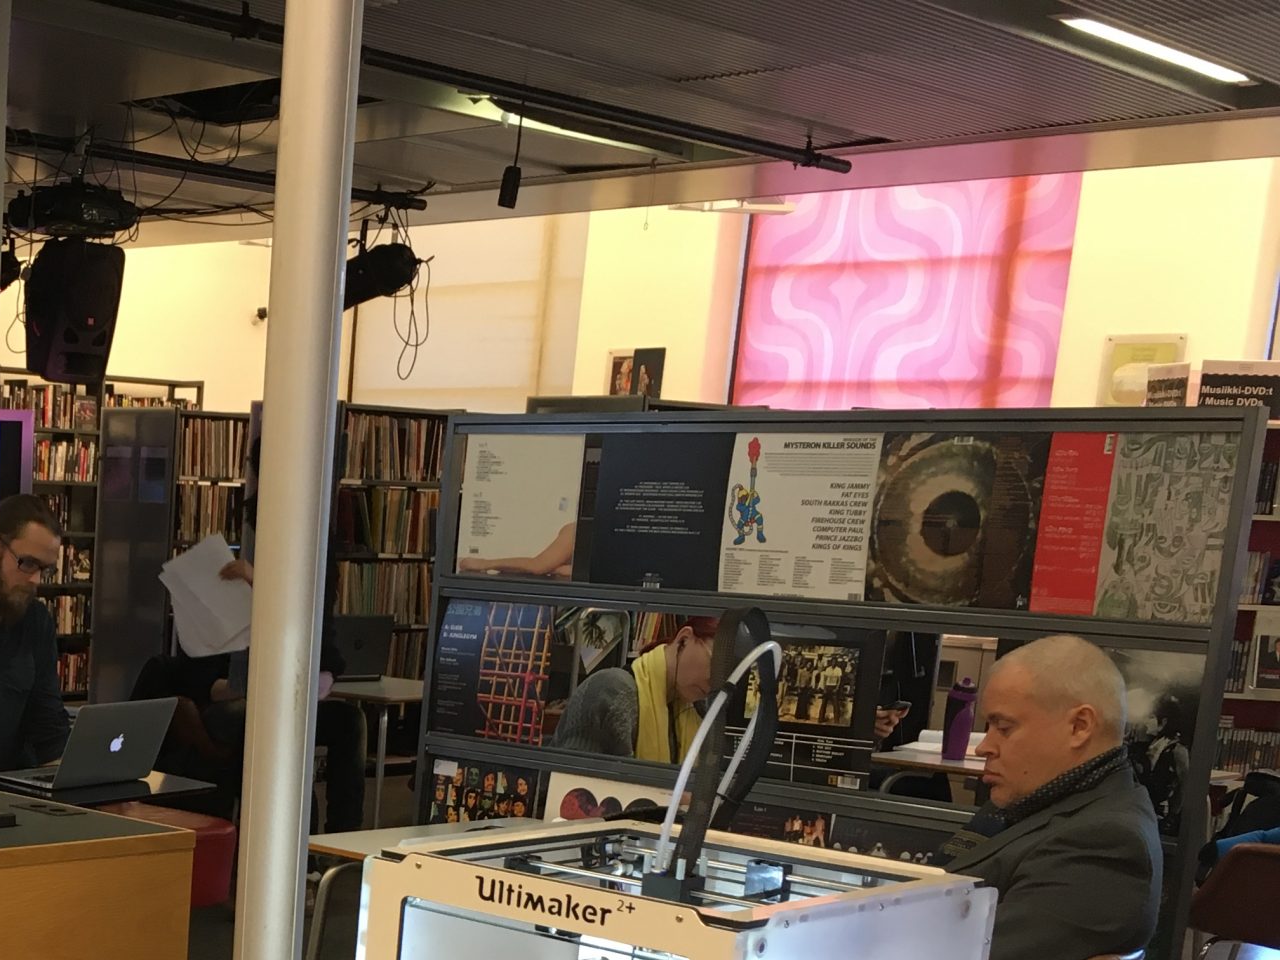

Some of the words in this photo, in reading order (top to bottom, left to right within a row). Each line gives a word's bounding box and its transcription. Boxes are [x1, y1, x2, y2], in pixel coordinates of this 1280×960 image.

[1201, 385, 1273, 396] Musiikki-DVD:t
[1205, 397, 1234, 406] Music
[1236, 397, 1264, 407] DVDs
[784, 441, 821, 449] MYSTERON
[822, 441, 845, 449] KILLER
[846, 442, 876, 450] SOUNDS
[815, 534, 838, 542] PRINCE
[475, 875, 612, 926] Ultimaker
[616, 899, 636, 914] 2+
